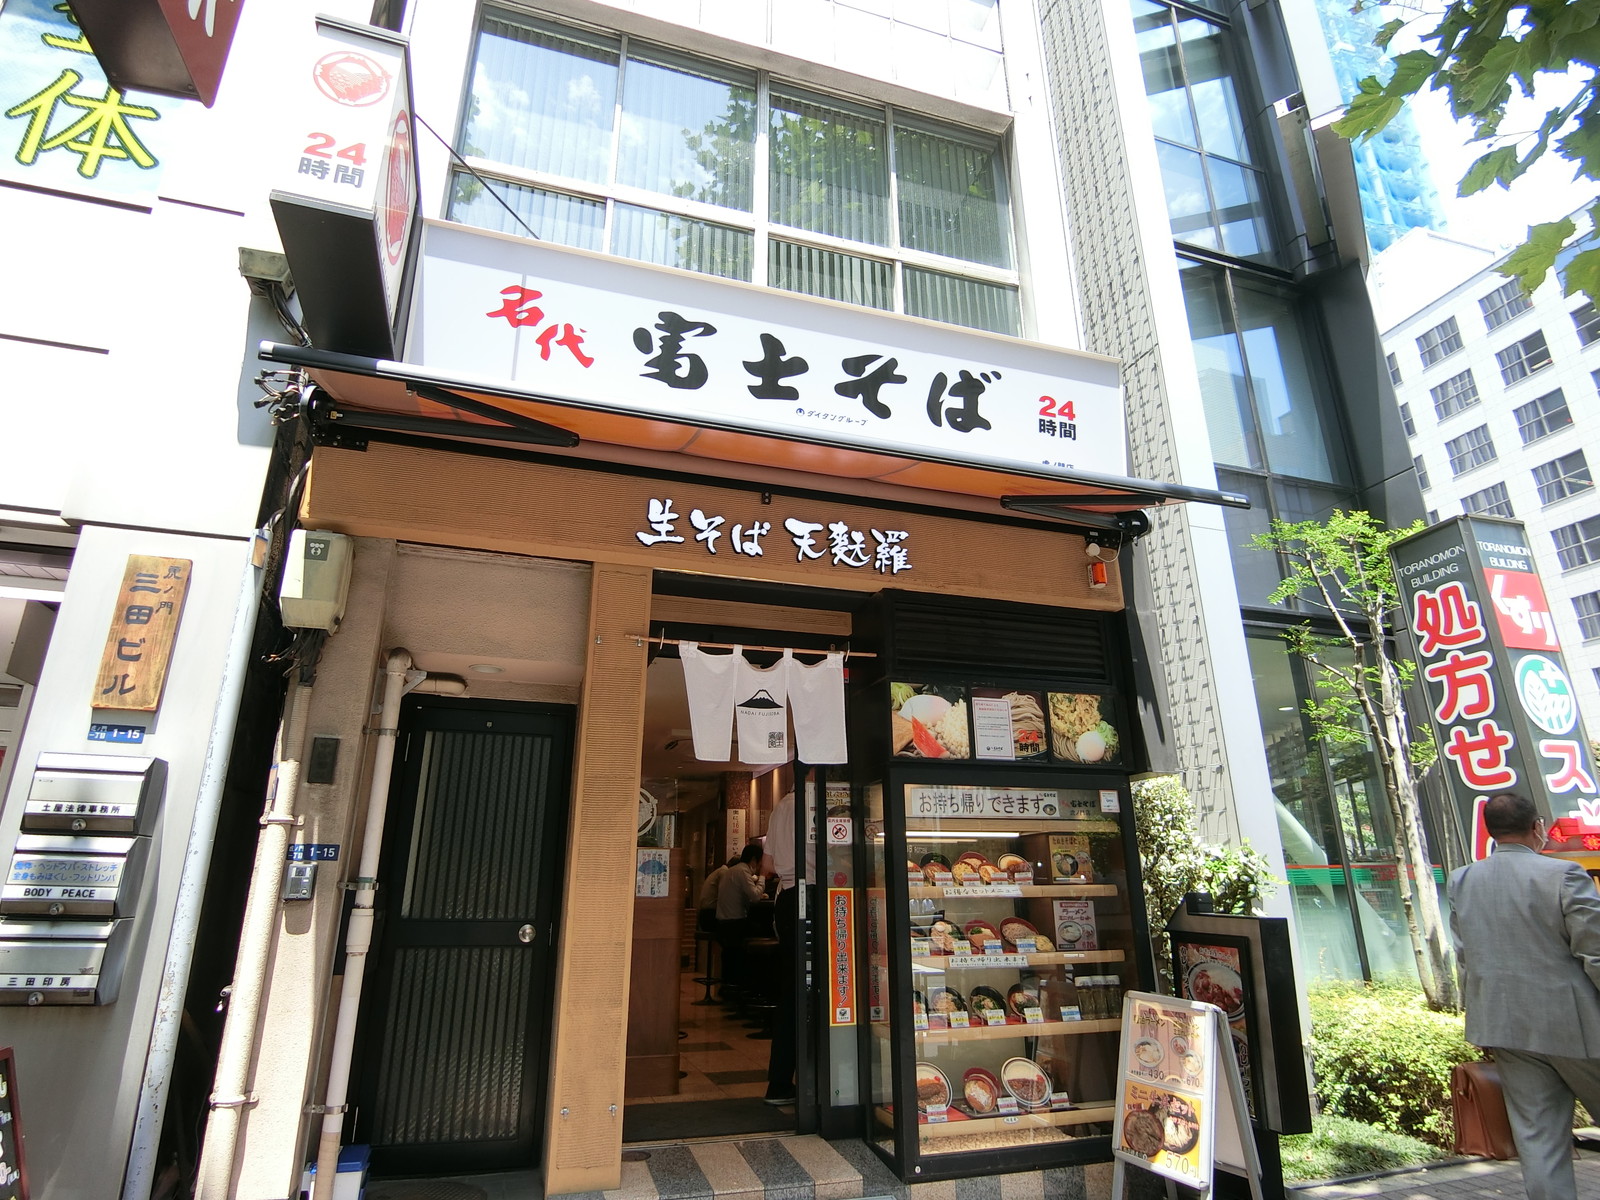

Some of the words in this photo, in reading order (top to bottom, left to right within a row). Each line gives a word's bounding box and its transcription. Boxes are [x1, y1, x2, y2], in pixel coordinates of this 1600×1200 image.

[303, 132, 367, 166] 24
[298, 157, 364, 188] 時間
[486, 285, 594, 369] 名代
[1039, 395, 1076, 421] 24
[1039, 418, 1076, 441] 時間
[1397, 543, 1465, 577] TORANOMON
[1477, 541, 1532, 557] TORANOMON
[1410, 562, 1459, 588] BUILDING
[1489, 557, 1529, 571] BUILDING
[102, 572, 162, 695] 三田ビル
[112, 728, 141, 739] 1-15
[41, 802, 121, 814] 土屋法律事務所
[919, 792, 1044, 815] お持ち帰りできます
[310, 847, 336, 858] 1-15
[23, 888, 53, 897] BODY
[61, 889, 97, 898] PEACE
